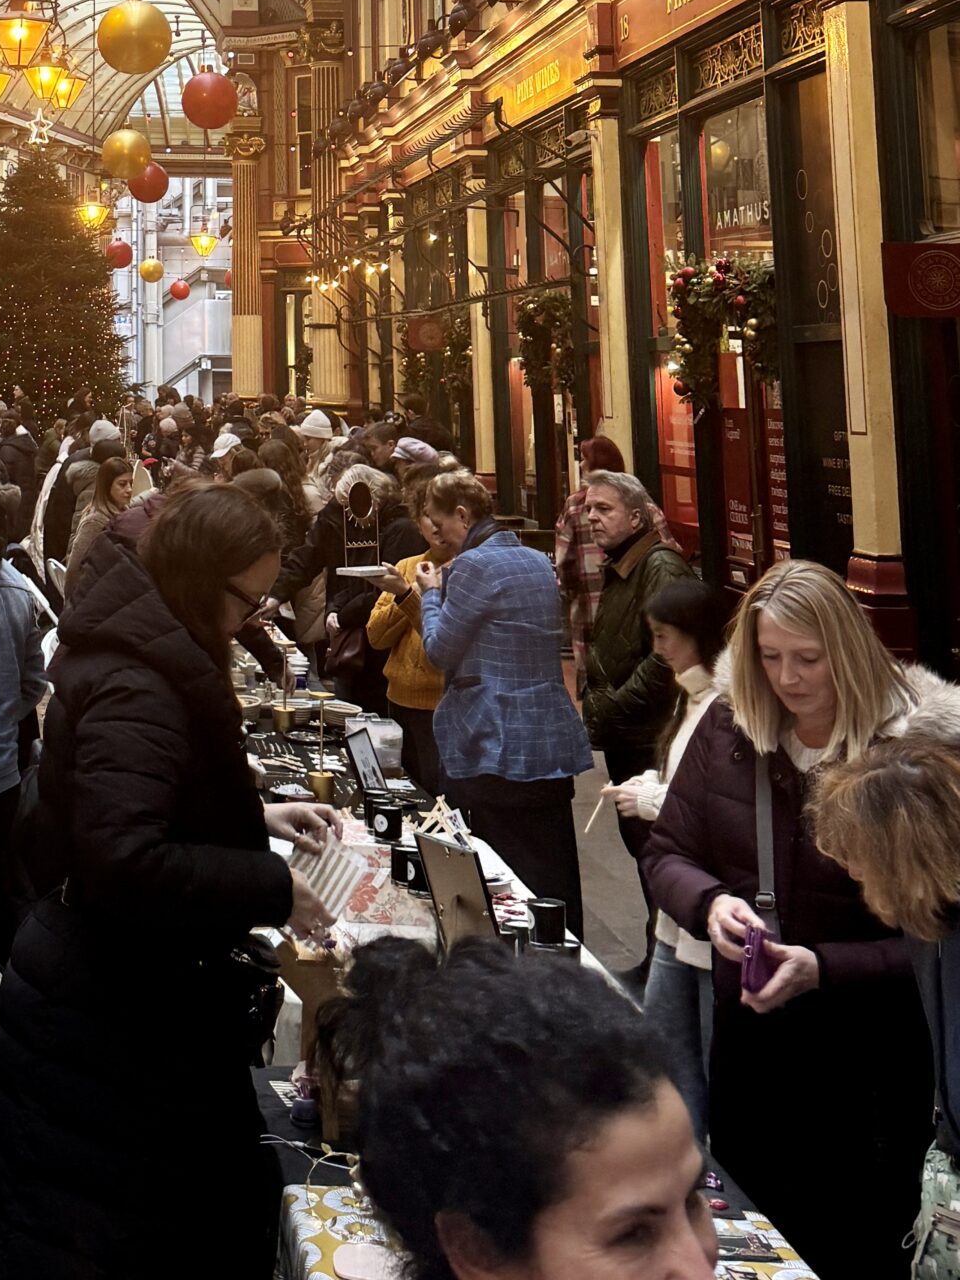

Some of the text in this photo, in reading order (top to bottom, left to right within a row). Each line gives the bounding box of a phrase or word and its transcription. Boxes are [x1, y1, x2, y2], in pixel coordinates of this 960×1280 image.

[619, 13, 629, 42] 18
[516, 59, 561, 105] FINE WINES
[716, 200, 770, 231] AMATHUS
[828, 484, 841, 497] FREE
